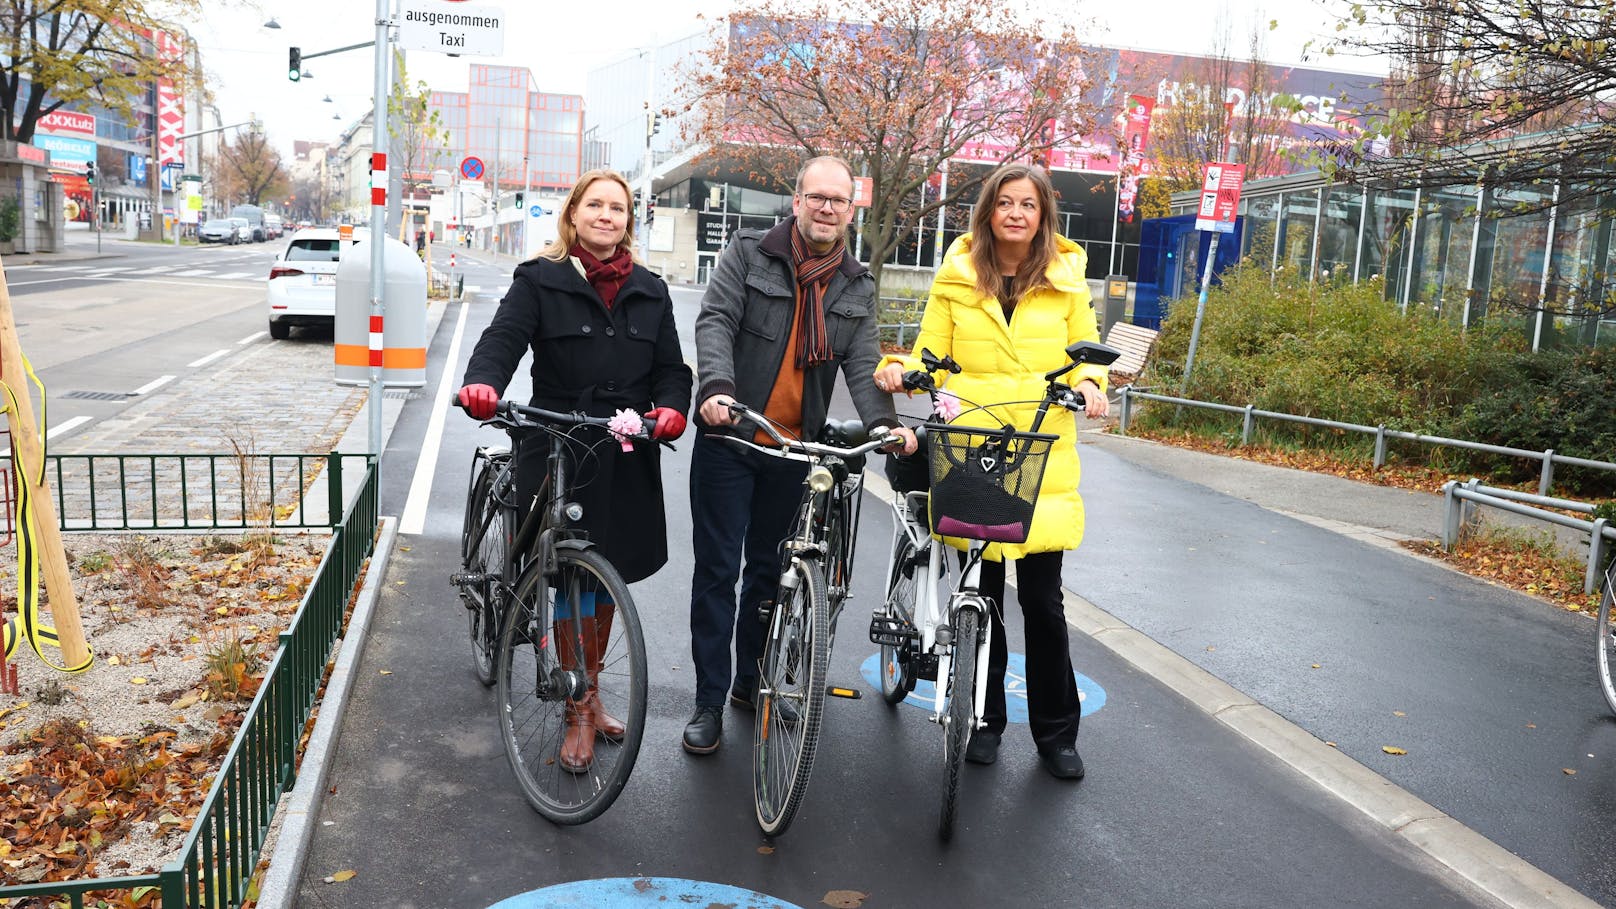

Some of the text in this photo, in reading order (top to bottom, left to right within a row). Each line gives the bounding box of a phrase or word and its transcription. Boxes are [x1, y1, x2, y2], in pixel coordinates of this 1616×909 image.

[406, 10, 499, 29] ausgenommen
[439, 32, 465, 47] Taxi
[41, 114, 93, 130] XXXLutz
[51, 161, 88, 171] restauran
[136, 157, 143, 168] P
